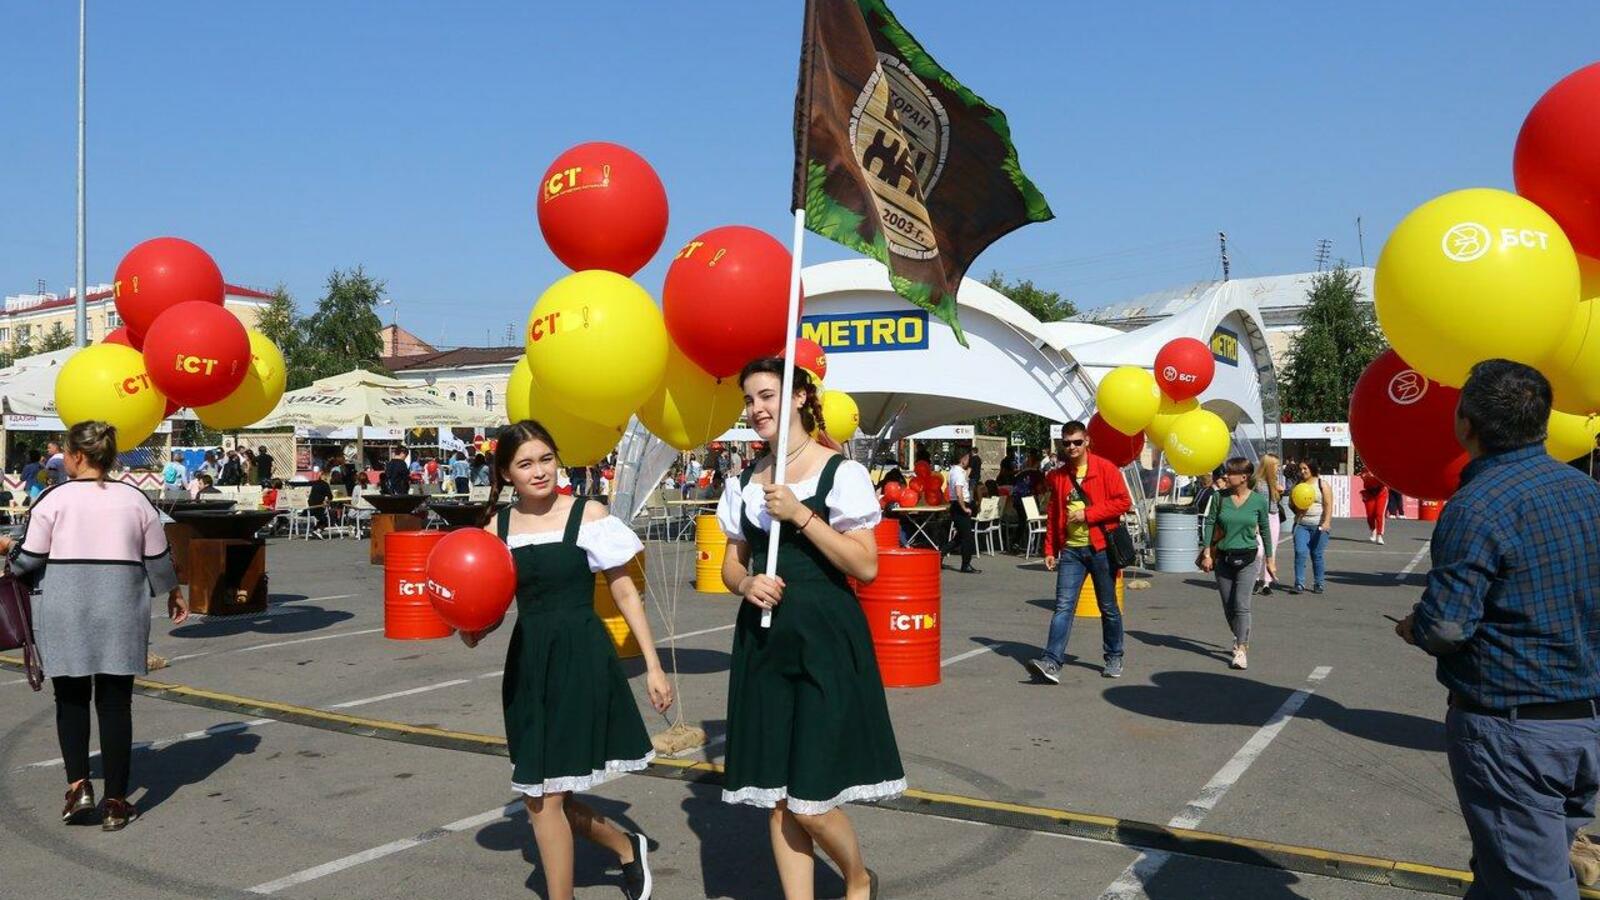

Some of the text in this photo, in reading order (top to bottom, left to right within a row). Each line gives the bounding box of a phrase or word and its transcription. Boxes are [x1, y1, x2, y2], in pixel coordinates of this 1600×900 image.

[882, 208, 915, 235] 2003
[1500, 228, 1549, 251] БСТ
[801, 317, 923, 347] METRO
[1178, 373, 1198, 383] БСТ
